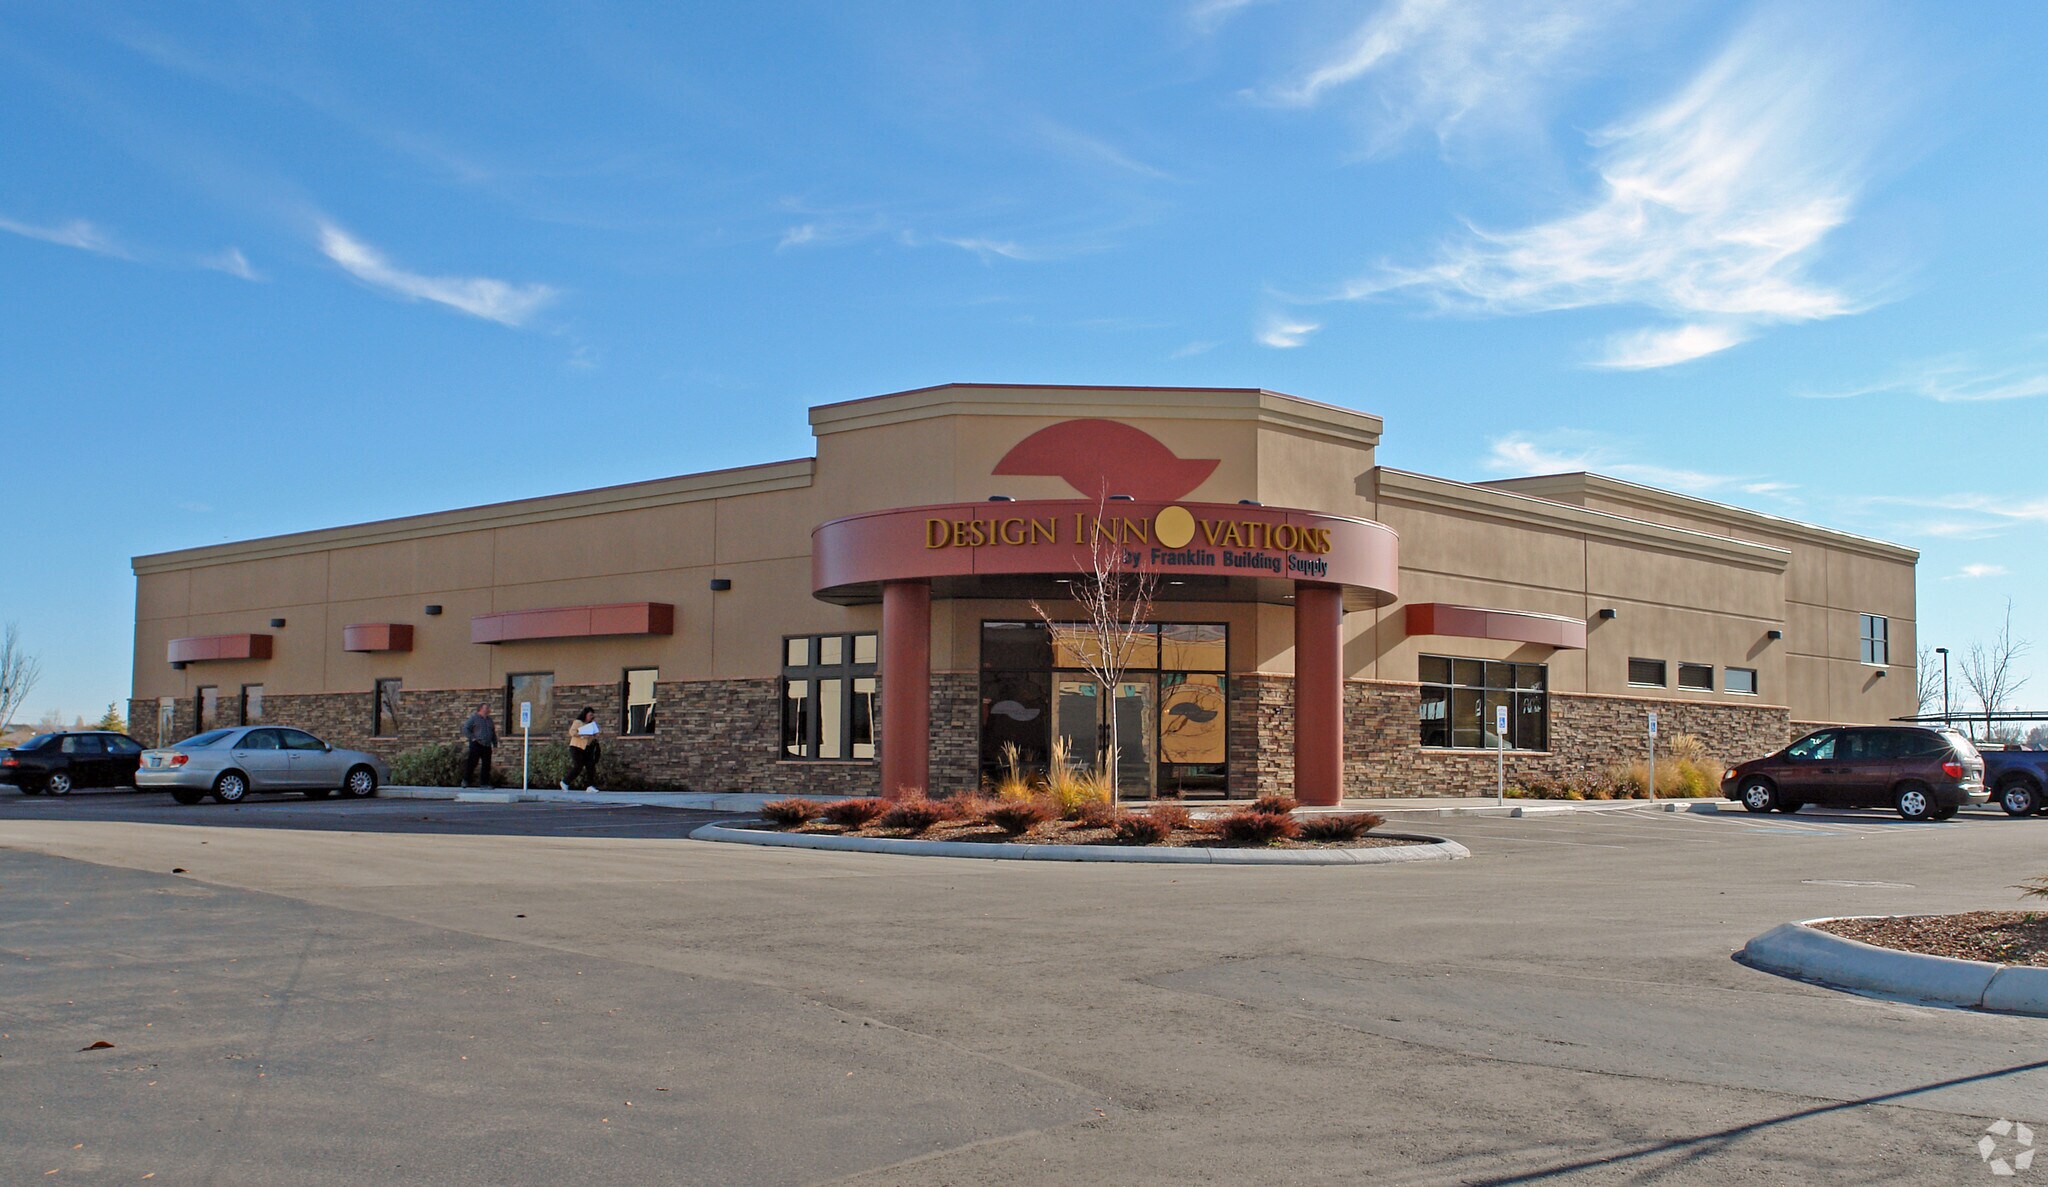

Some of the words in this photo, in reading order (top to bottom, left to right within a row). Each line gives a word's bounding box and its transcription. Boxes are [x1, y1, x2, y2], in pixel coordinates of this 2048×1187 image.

[925, 516, 1058, 549] DESIGN
[1123, 548, 1141, 568] by
[1151, 548, 1216, 567] Franklin
[1223, 550, 1281, 573] Building
[1288, 554, 1328, 577] Supply
